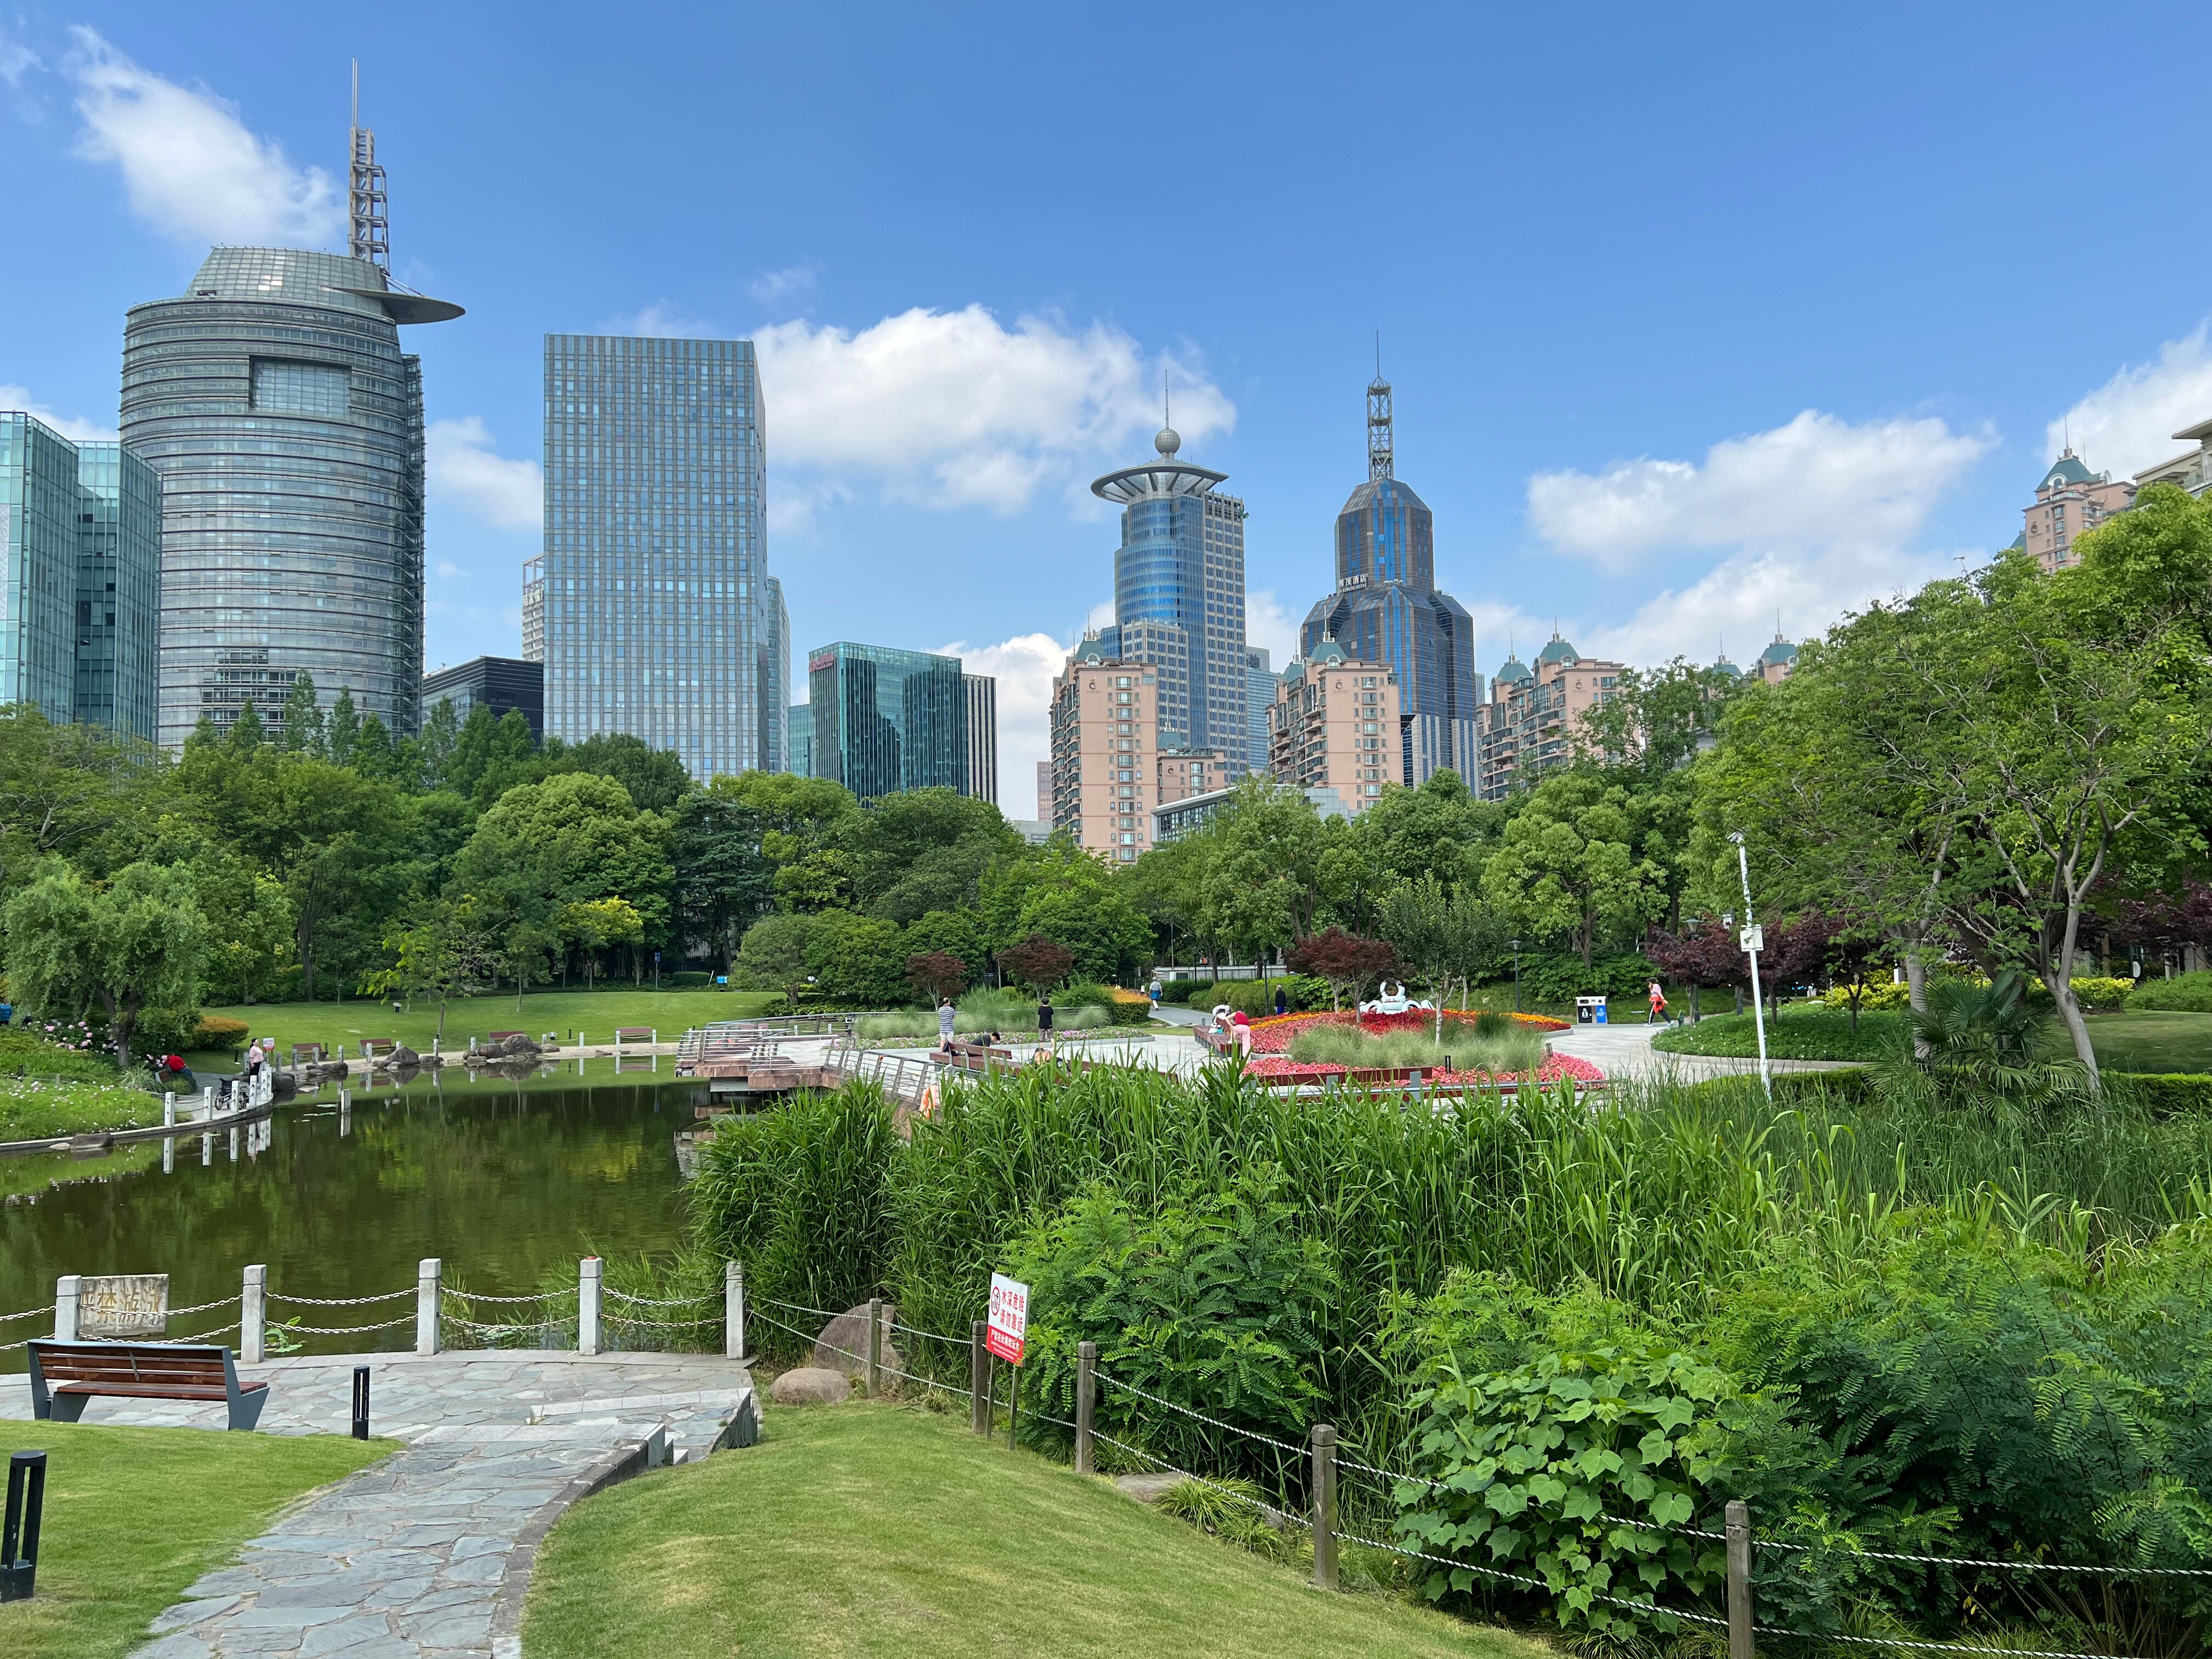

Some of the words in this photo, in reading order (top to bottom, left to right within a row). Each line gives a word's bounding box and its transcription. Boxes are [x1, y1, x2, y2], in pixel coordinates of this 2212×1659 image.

[1001, 1288, 1024, 1313] 水深危险
[1000, 1308, 1023, 1333] 请勿靠近
